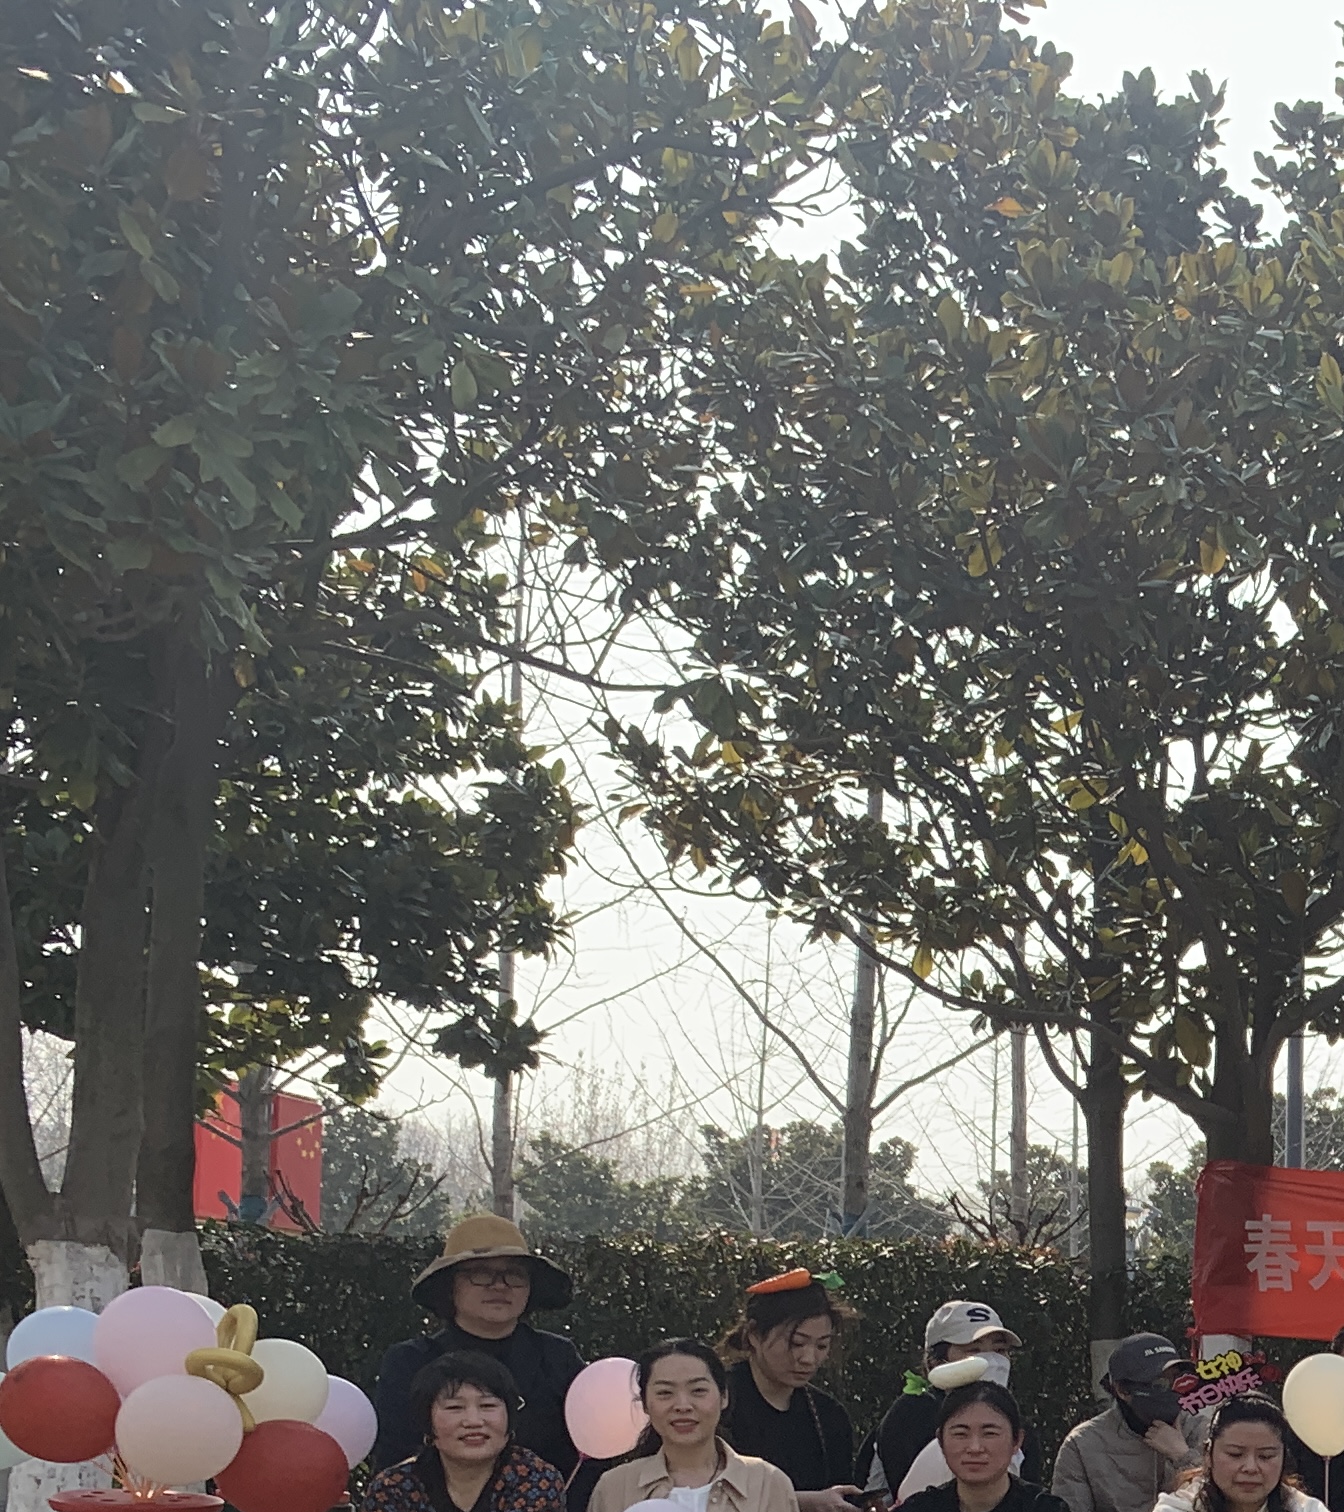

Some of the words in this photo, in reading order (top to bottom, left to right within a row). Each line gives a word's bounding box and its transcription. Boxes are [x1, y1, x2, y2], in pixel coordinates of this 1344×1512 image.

[966, 1307, 990, 1322] S
[1195, 1350, 1243, 1380] 女神
[1178, 1366, 1263, 1416] 节日快乐
